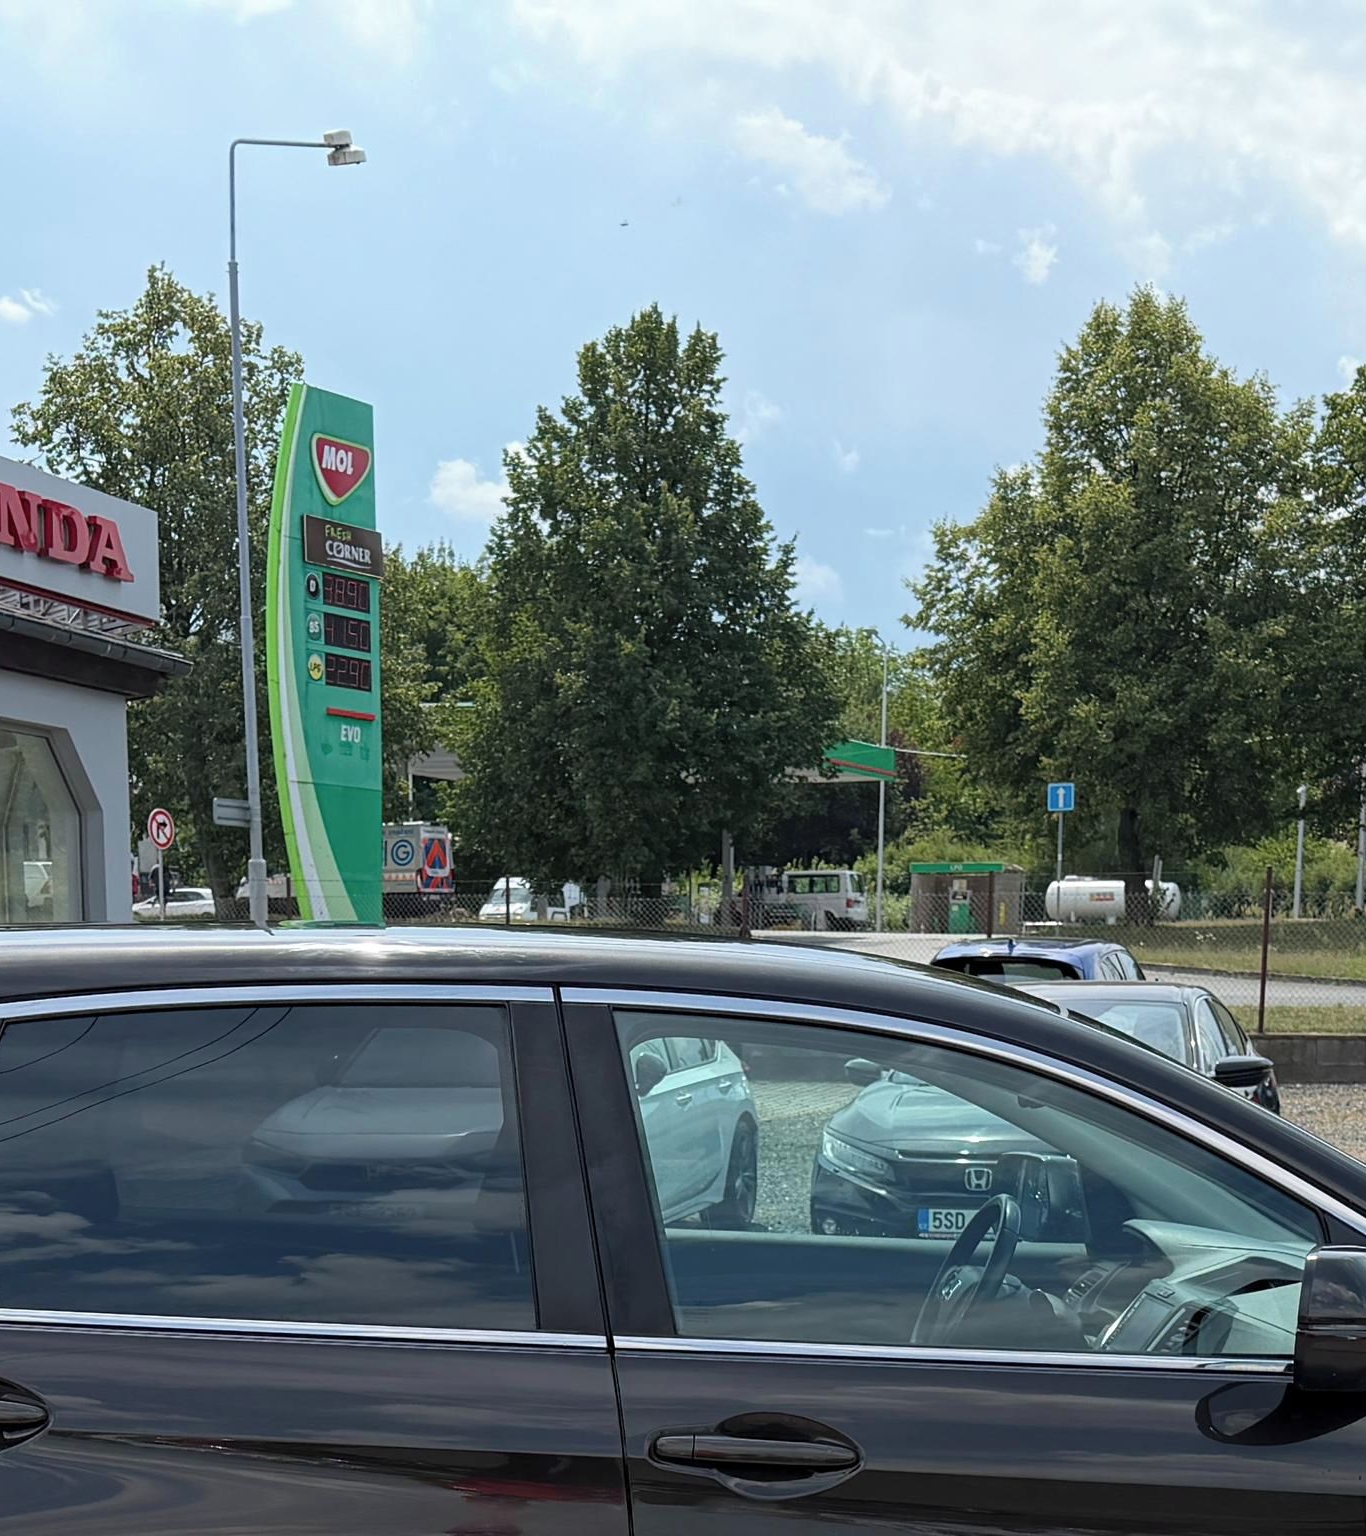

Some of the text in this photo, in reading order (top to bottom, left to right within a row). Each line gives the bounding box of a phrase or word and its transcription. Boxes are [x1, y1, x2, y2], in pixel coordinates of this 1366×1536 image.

[322, 444, 354, 475] MOL
[325, 524, 352, 542] FRESH
[325, 540, 372, 564] CORNER
[309, 579, 317, 593] D
[309, 661, 322, 673] LPG
[340, 724, 361, 743] EVO
[932, 1211, 965, 1230] 5SD
